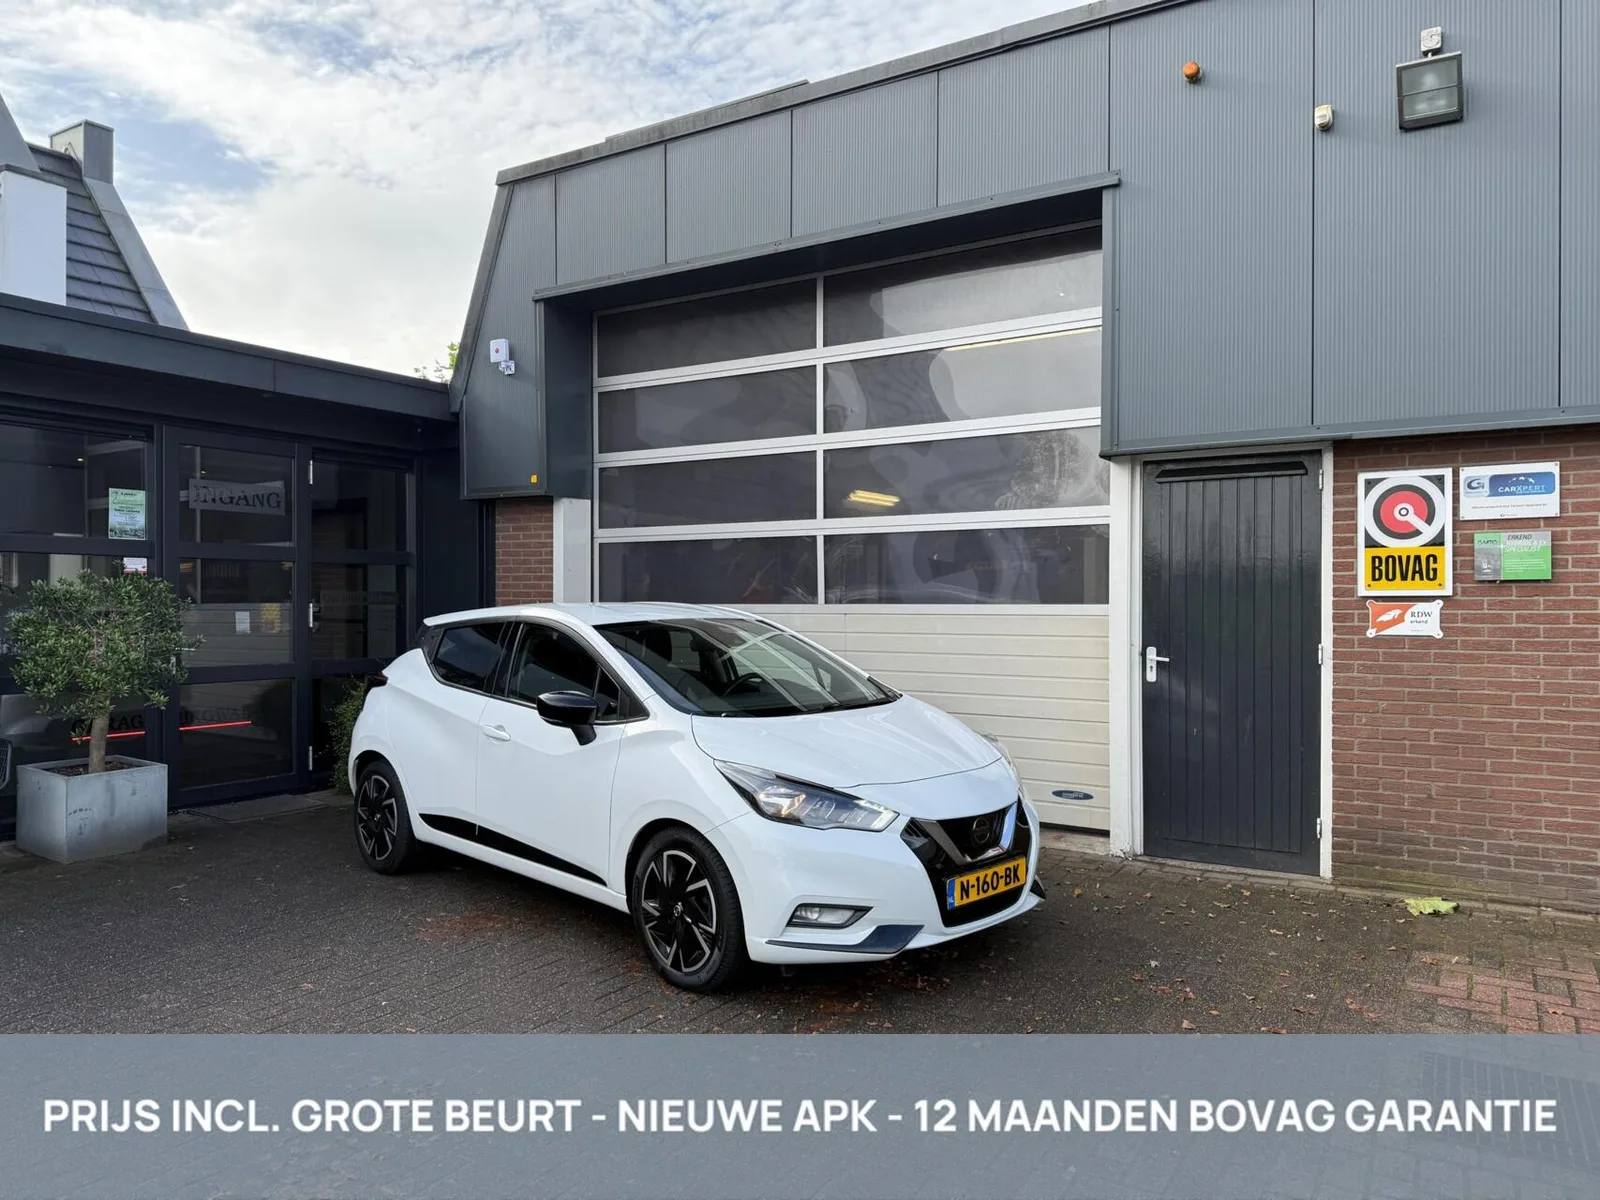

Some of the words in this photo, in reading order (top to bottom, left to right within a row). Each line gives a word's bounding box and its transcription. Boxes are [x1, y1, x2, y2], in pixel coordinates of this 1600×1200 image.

[1498, 484, 1546, 493] CARXPERT
[1507, 533, 1533, 541] ERKEND
[1371, 554, 1438, 582] BOVAG
[1410, 610, 1433, 618] RDW
[960, 863, 1021, 901] N-160-BK
